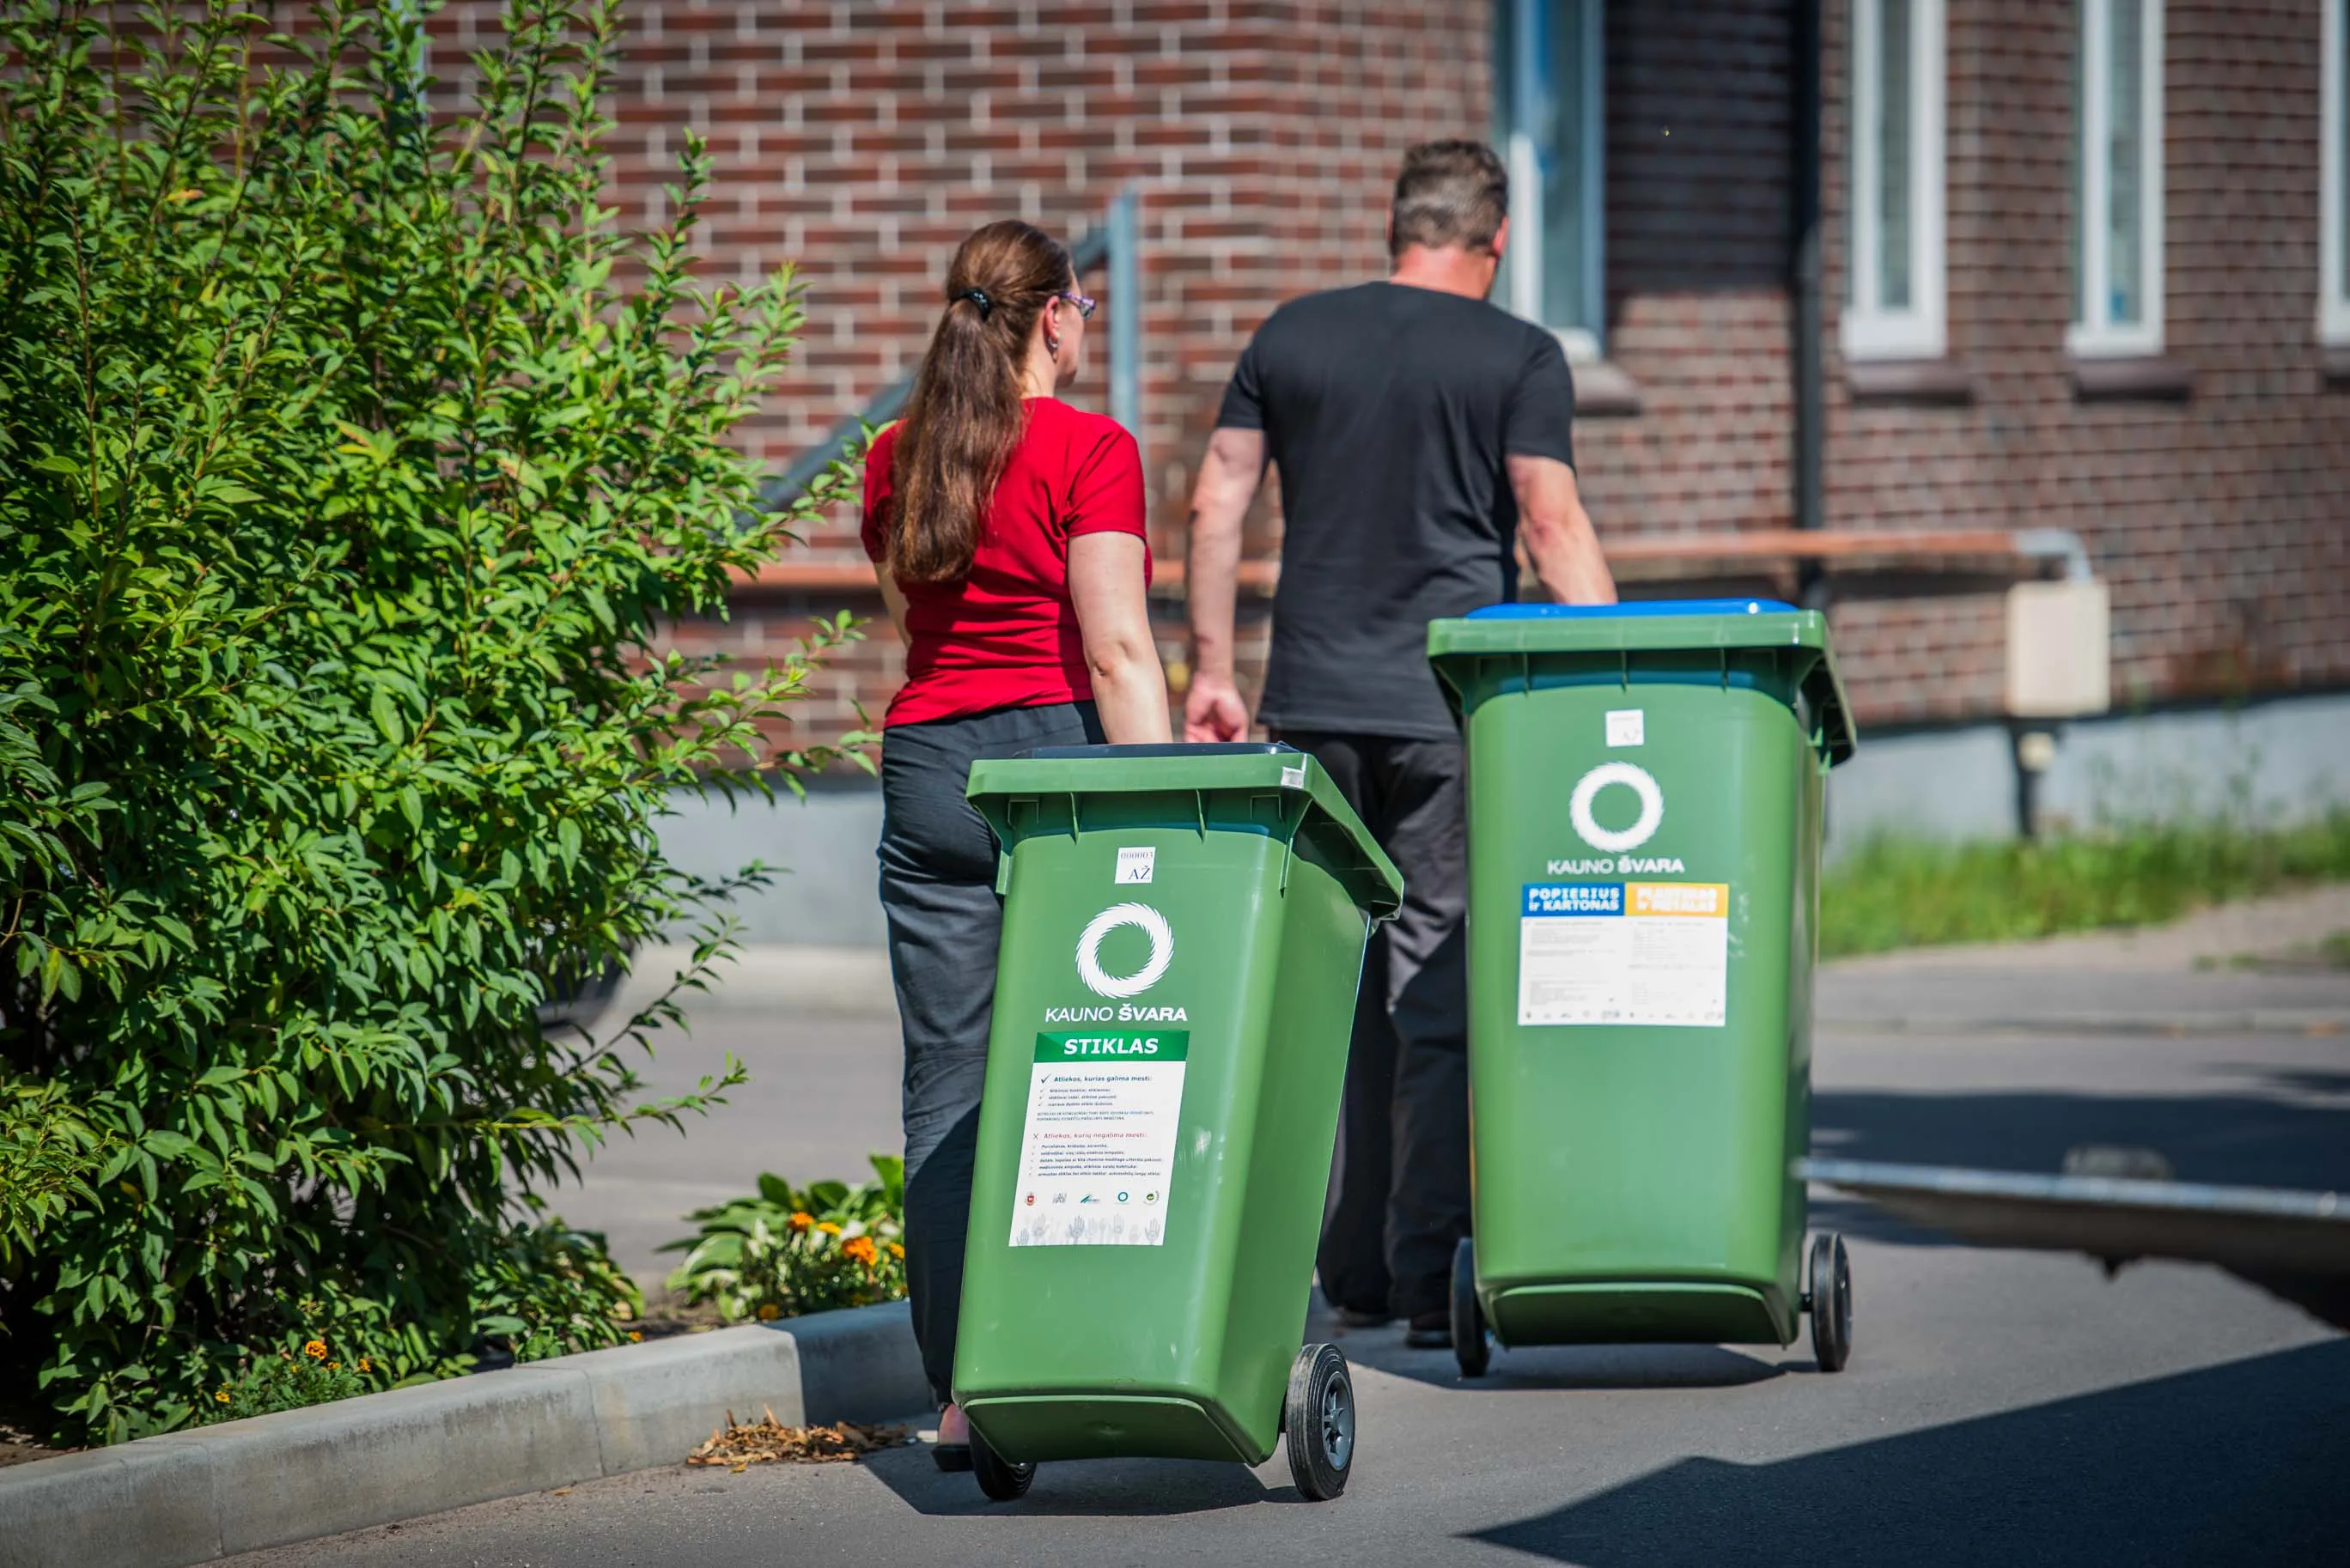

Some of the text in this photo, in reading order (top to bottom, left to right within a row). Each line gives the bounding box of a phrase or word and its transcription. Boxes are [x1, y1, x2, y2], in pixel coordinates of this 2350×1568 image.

[1547, 854, 1685, 875] KAUNO ŠVARA
[1128, 866, 1150, 879] AŽ
[1528, 887, 1620, 901] POPIERIUS
[1543, 899, 1620, 911] KARTONAS
[1044, 1003, 1188, 1023] KAUNO ŠVARA
[1063, 1037, 1159, 1055] STIKLAS
[1053, 1075, 1082, 1084] Atliekos,
[1084, 1074, 1105, 1083] kurias
[1106, 1074, 1129, 1084] galima
[1093, 1132, 1124, 1140] negalima
